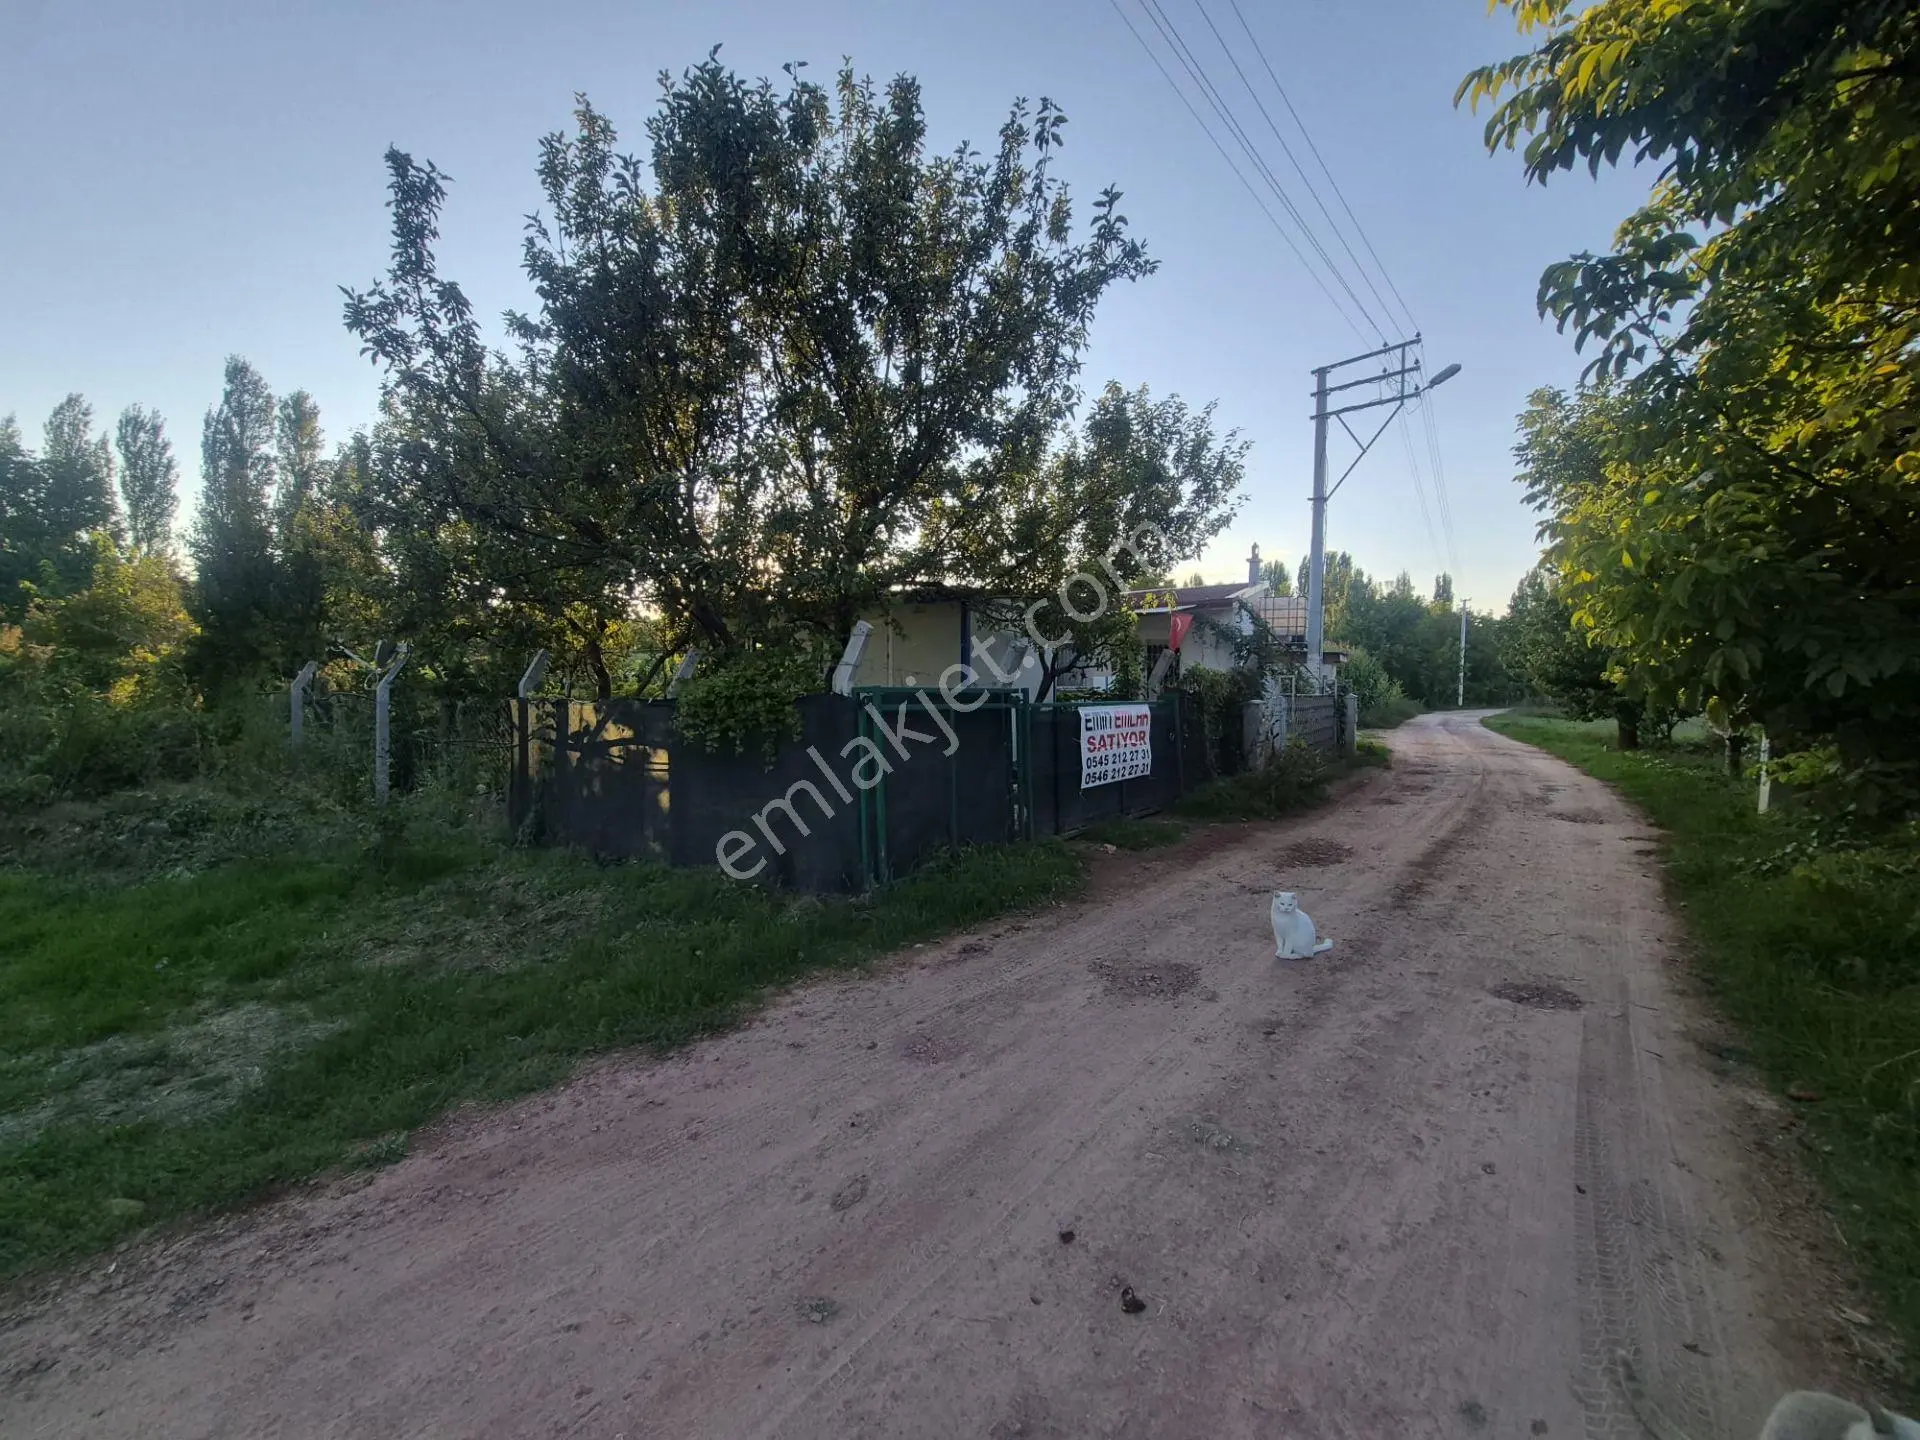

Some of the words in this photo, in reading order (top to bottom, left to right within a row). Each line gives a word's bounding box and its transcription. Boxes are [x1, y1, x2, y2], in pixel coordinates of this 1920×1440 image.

[1087, 731, 1147, 753] SATIYOR
[1086, 754, 1109, 769] 0545
[1112, 752, 1127, 765] 212
[1130, 750, 1139, 761] 27
[1141, 748, 1150, 759] 31
[1085, 770, 1108, 784] 0546
[1111, 767, 1126, 780] 212
[1128, 765, 1139, 776] 27
[1141, 763, 1149, 773] 31
